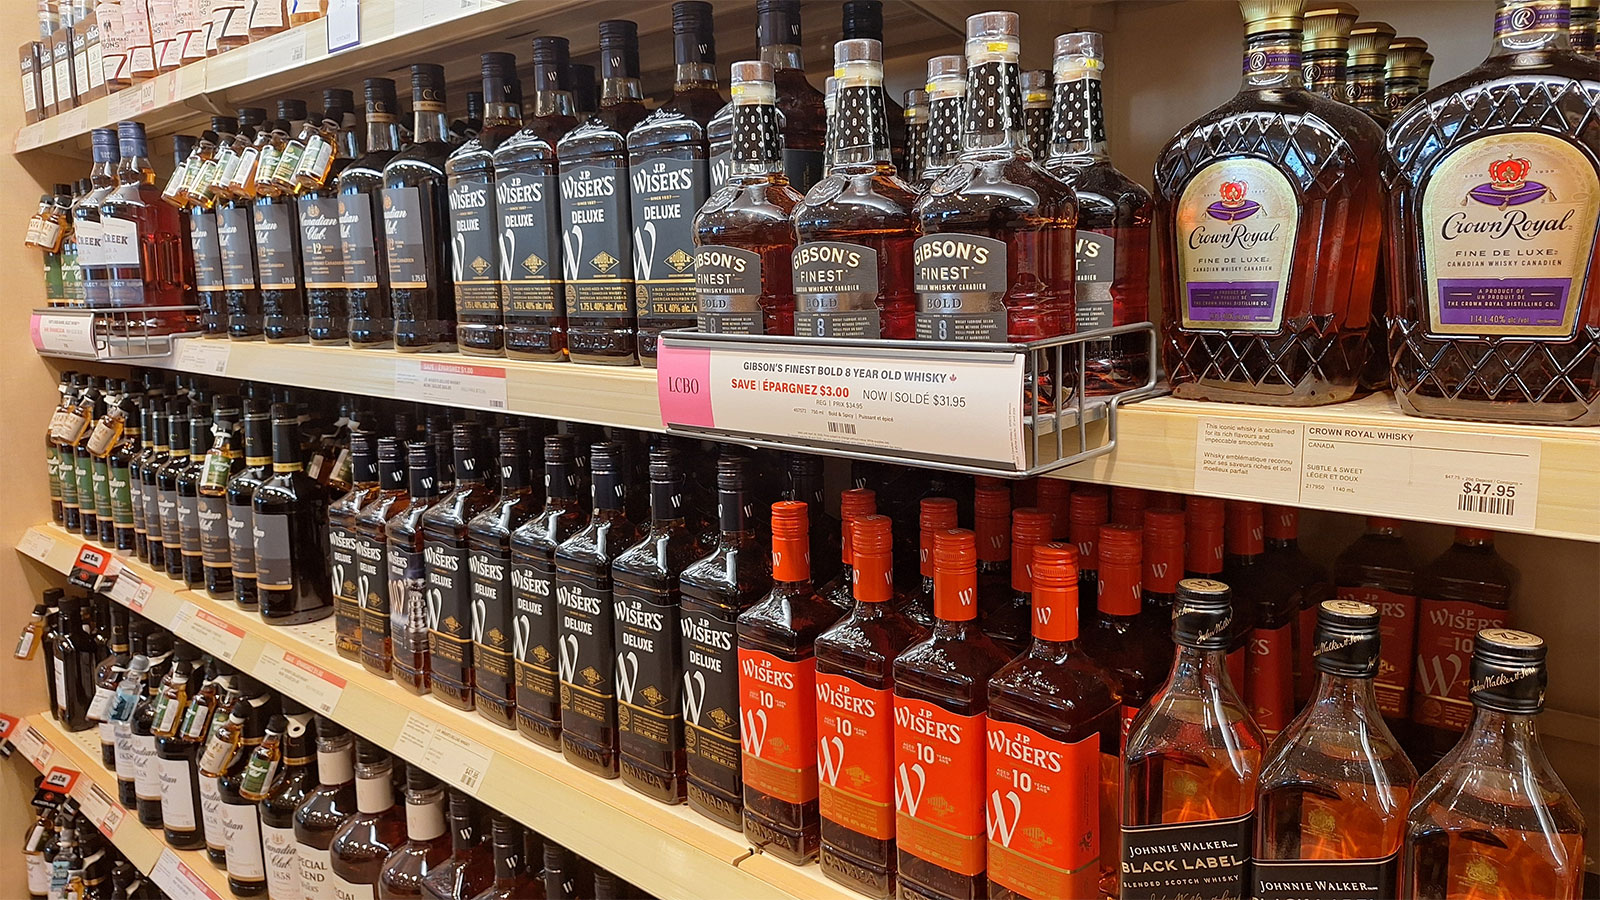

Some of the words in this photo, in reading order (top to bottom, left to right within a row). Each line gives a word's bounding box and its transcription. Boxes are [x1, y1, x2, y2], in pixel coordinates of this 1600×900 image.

[562, 176, 614, 199] WISER'S
[633, 168, 692, 194] WISER'S
[497, 183, 541, 204] WISER'S
[505, 214, 533, 228] DELUXE
[572, 209, 604, 224] DELUXE
[644, 204, 681, 220] DELUXE
[457, 219, 480, 232] DELUXE
[1441, 212, 1501, 241] Crown
[1490, 209, 1575, 241] Royal
[1189, 226, 1230, 250] Crown
[1222, 223, 1280, 250] Royal
[312, 243, 322, 254] 12
[914, 240, 988, 266] GIBSON'S
[794, 246, 860, 270] GIBSON'S
[800, 270, 843, 283] FINEST
[922, 267, 969, 281] FINEST
[806, 297, 838, 308] BOLD
[927, 297, 962, 309] BOLD
[817, 318, 825, 336] 8
[939, 320, 947, 340] 8
[743, 361, 783, 372] GIBSON'S
[784, 362, 816, 375] FINEST
[818, 366, 843, 378] BOLD
[845, 368, 851, 378] 8
[853, 370, 878, 380] YEAR
[880, 372, 902, 382] OLD
[904, 372, 947, 384] WHISKY
[668, 376, 699, 394] LCBO
[731, 378, 756, 391] SAVE
[763, 381, 817, 396] ÉPARGNEZ
[820, 386, 849, 398] $3.00
[863, 389, 887, 402] NOW
[895, 392, 929, 405] SOLDÉ
[933, 395, 966, 408] $31.95
[1264, 427, 1295, 435] acclaimed
[1308, 427, 1342, 437] CROWN
[1344, 430, 1374, 439] ROYAL
[1377, 432, 1414, 441] WHISKY
[1205, 437, 1237, 445] impeccable
[1238, 440, 1274, 448] smoothness
[1308, 442, 1335, 450] CANADA
[1204, 452, 1224, 460] Whisky
[1226, 453, 1266, 462] emblématique
[1306, 464, 1331, 472] SUBTLE
[1306, 472, 1328, 480] LÉGER
[1463, 482, 1515, 498] $47.95
[84, 553, 99, 562] pts
[430, 573, 452, 589] DELUXE
[511, 570, 549, 597] WISER'S
[475, 583, 496, 600] DELUXE
[517, 599, 543, 616] DELUXE
[556, 587, 600, 616] WISER'S
[614, 600, 662, 631] WISER'S
[564, 616, 593, 635] DELUXE
[681, 616, 732, 651] WISER'S
[623, 632, 654, 652] DELUXE
[689, 651, 722, 673] DELUXE
[742, 658, 794, 690] WISER'S
[760, 689, 774, 709] 10
[816, 682, 875, 718] WISER'S
[835, 716, 852, 736] 10
[894, 706, 961, 744] WISER'S
[916, 743, 935, 765] 10
[987, 730, 1062, 773] WISER'S
[51, 774, 66, 783] pts
[622, 760, 663, 788] CANADA
[1012, 769, 1032, 793] 10
[1129, 844, 1179, 858] JOHNNIE
[1180, 840, 1229, 853] WALKER
[1122, 859, 1178, 873] BLACK
[1182, 855, 1242, 870] LABEL
[1165, 878, 1200, 886] SCOTCH
[1203, 874, 1239, 884] WHISKY
[1260, 881, 1312, 894] JOHNNIE
[1314, 880, 1368, 892] WALKER
